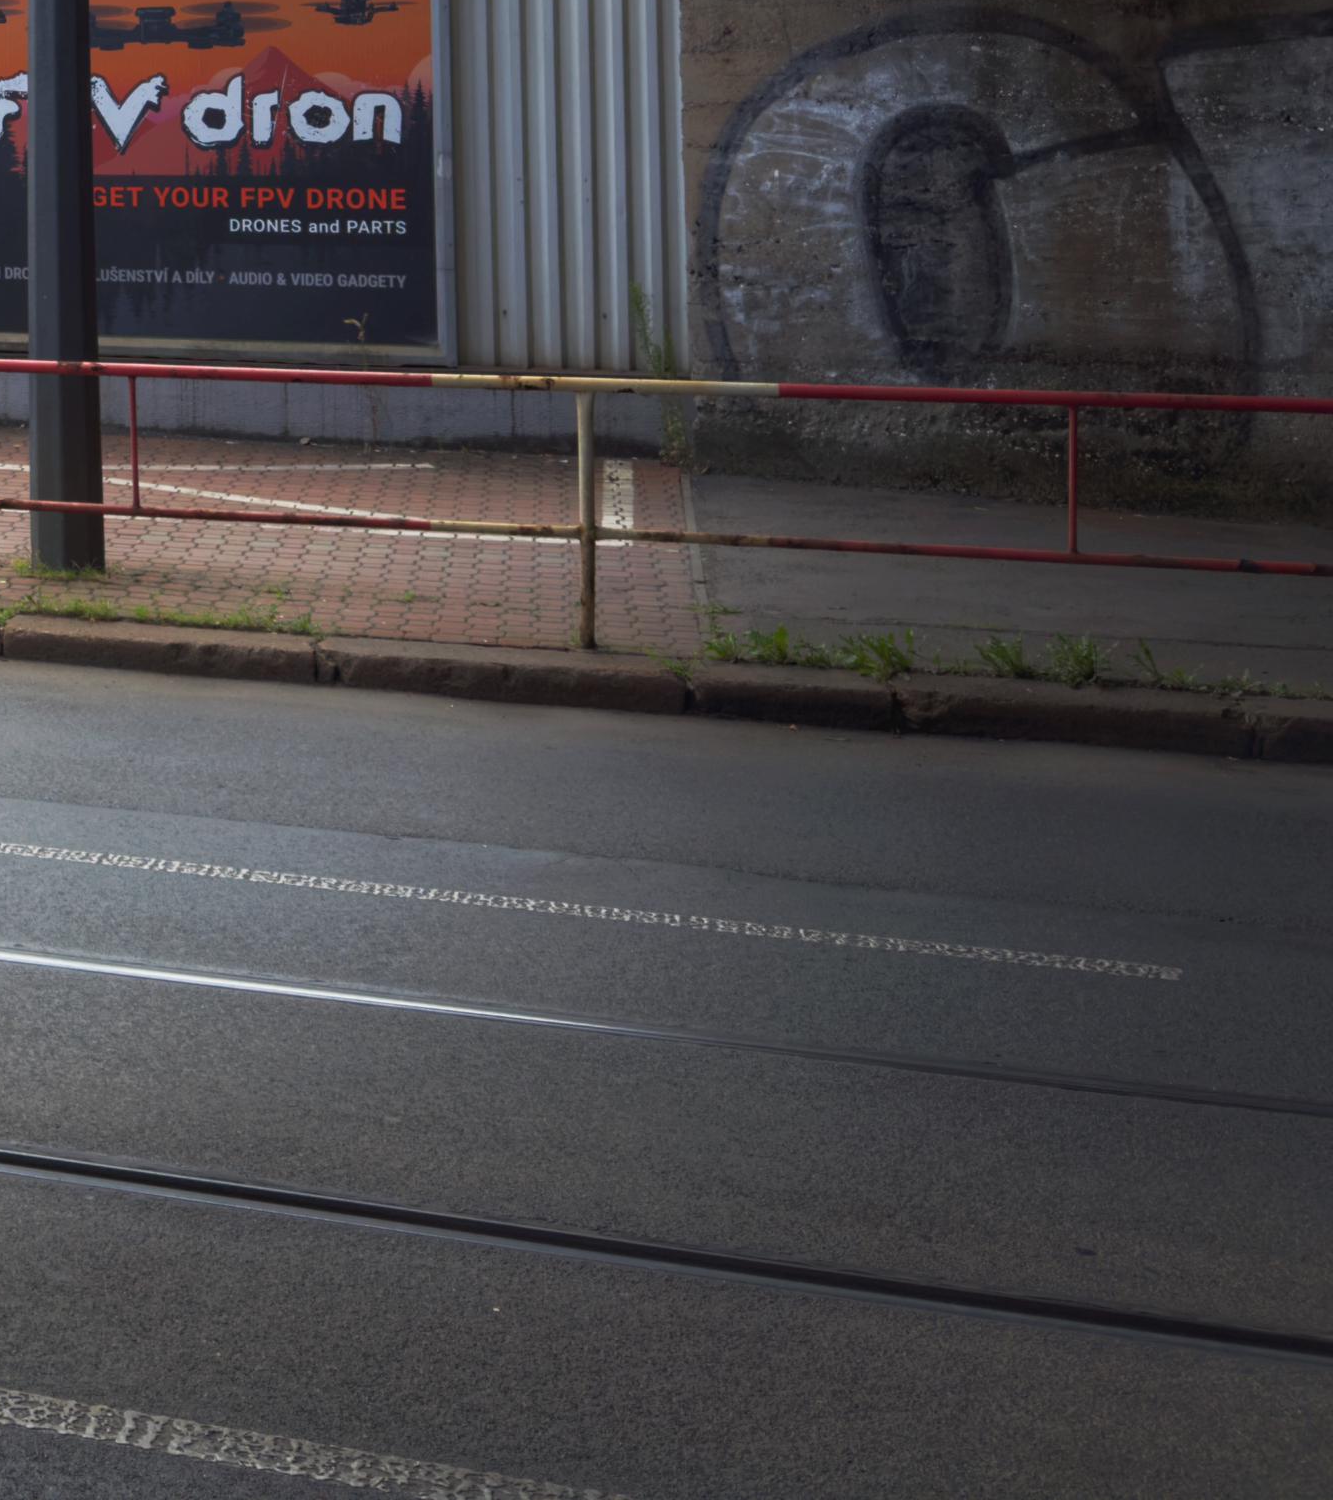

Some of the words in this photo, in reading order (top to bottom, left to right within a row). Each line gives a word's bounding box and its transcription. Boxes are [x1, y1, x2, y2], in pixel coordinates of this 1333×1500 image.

[182, 74, 403, 146] dron
[93, 186, 144, 208] GET
[153, 186, 230, 208] YOUR
[240, 187, 295, 209] FPV
[306, 188, 407, 210] DRONE
[229, 218, 302, 233] DRONES
[308, 219, 340, 234] and
[346, 220, 407, 235] PARTS
[4, 266, 29, 280] DRO
[171, 269, 183, 284] A
[185, 267, 215, 284] DÍLY
[228, 271, 273, 286] AUDIO
[276, 272, 288, 286] &
[290, 272, 334, 287] VIDEO
[337, 273, 407, 289] GADGETY
